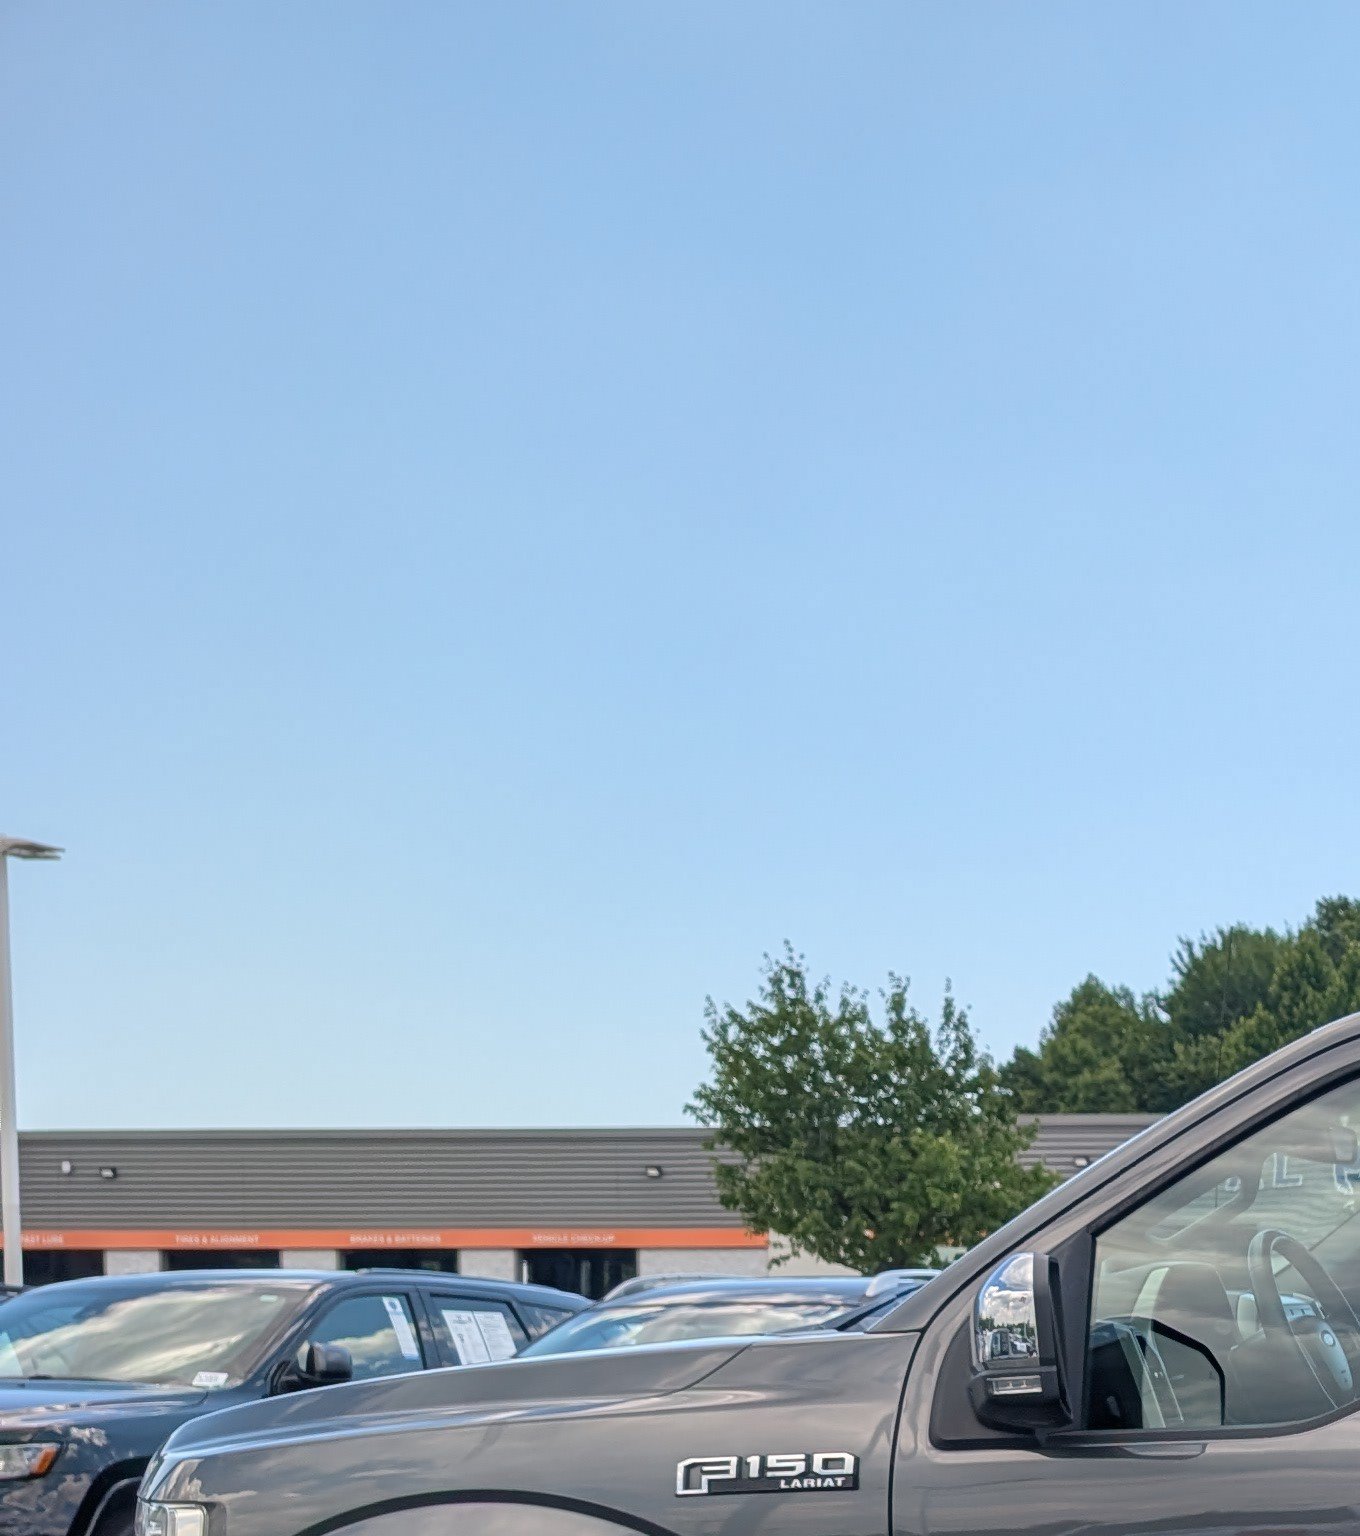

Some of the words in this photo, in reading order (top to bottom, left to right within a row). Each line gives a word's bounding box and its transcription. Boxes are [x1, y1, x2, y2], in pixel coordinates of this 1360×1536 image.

[209, 1233, 259, 1243] ALIGNMENT
[394, 1233, 442, 1243] BATTERIES
[779, 1476, 846, 1489] LARIAT
